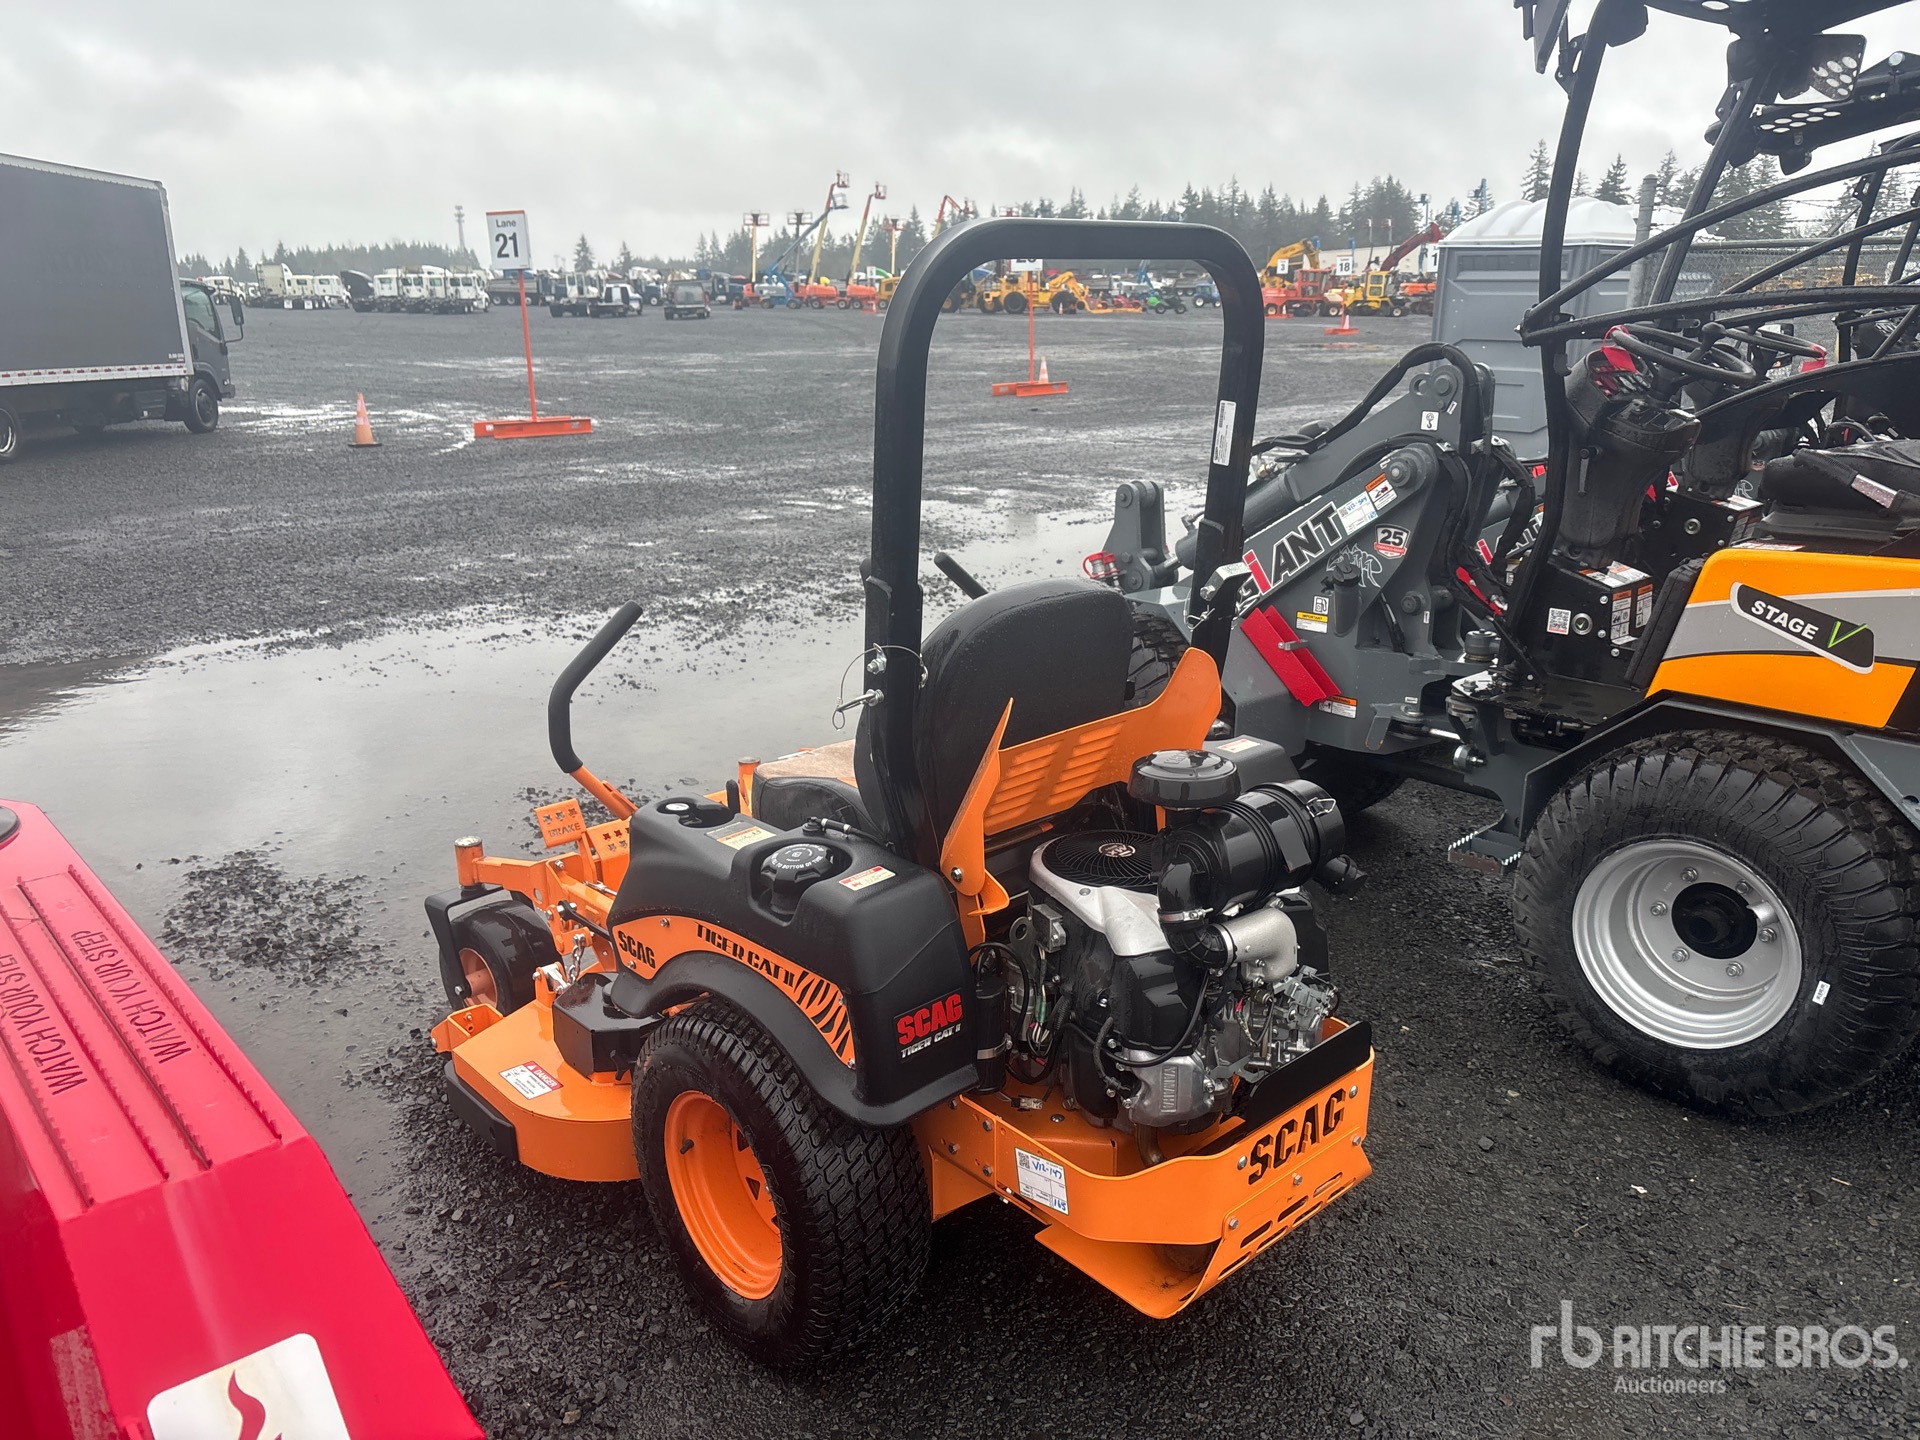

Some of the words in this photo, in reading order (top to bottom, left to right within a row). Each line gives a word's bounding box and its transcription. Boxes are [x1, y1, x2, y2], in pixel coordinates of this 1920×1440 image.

[496, 219, 516, 228] Lane
[495, 232, 519, 258] 21
[1280, 263, 1286, 271] 3
[1339, 262, 1350, 272] 18
[1380, 529, 1404, 547] 25
[1751, 600, 1819, 640] STAGE
[1827, 620, 1868, 649] V
[548, 822, 581, 838] BRAKE
[70, 930, 119, 962] STEP
[618, 930, 656, 969] SCAG
[695, 922, 746, 961] TIGER
[747, 952, 780, 981] CAT
[780, 969, 795, 987] II
[94, 959, 147, 1004] YOUR
[0, 984, 50, 1031] YOUR
[897, 994, 962, 1045] SCAG
[121, 999, 192, 1064] WATCH
[901, 1036, 932, 1058] TIGER
[934, 1025, 955, 1043] CAT
[955, 1023, 962, 1032] II
[21, 1026, 88, 1096] WATCH
[532, 1069, 558, 1087] DANGER
[1163, 1066, 1177, 1110] YAMAHA
[1248, 1088, 1346, 1185] SCAG
